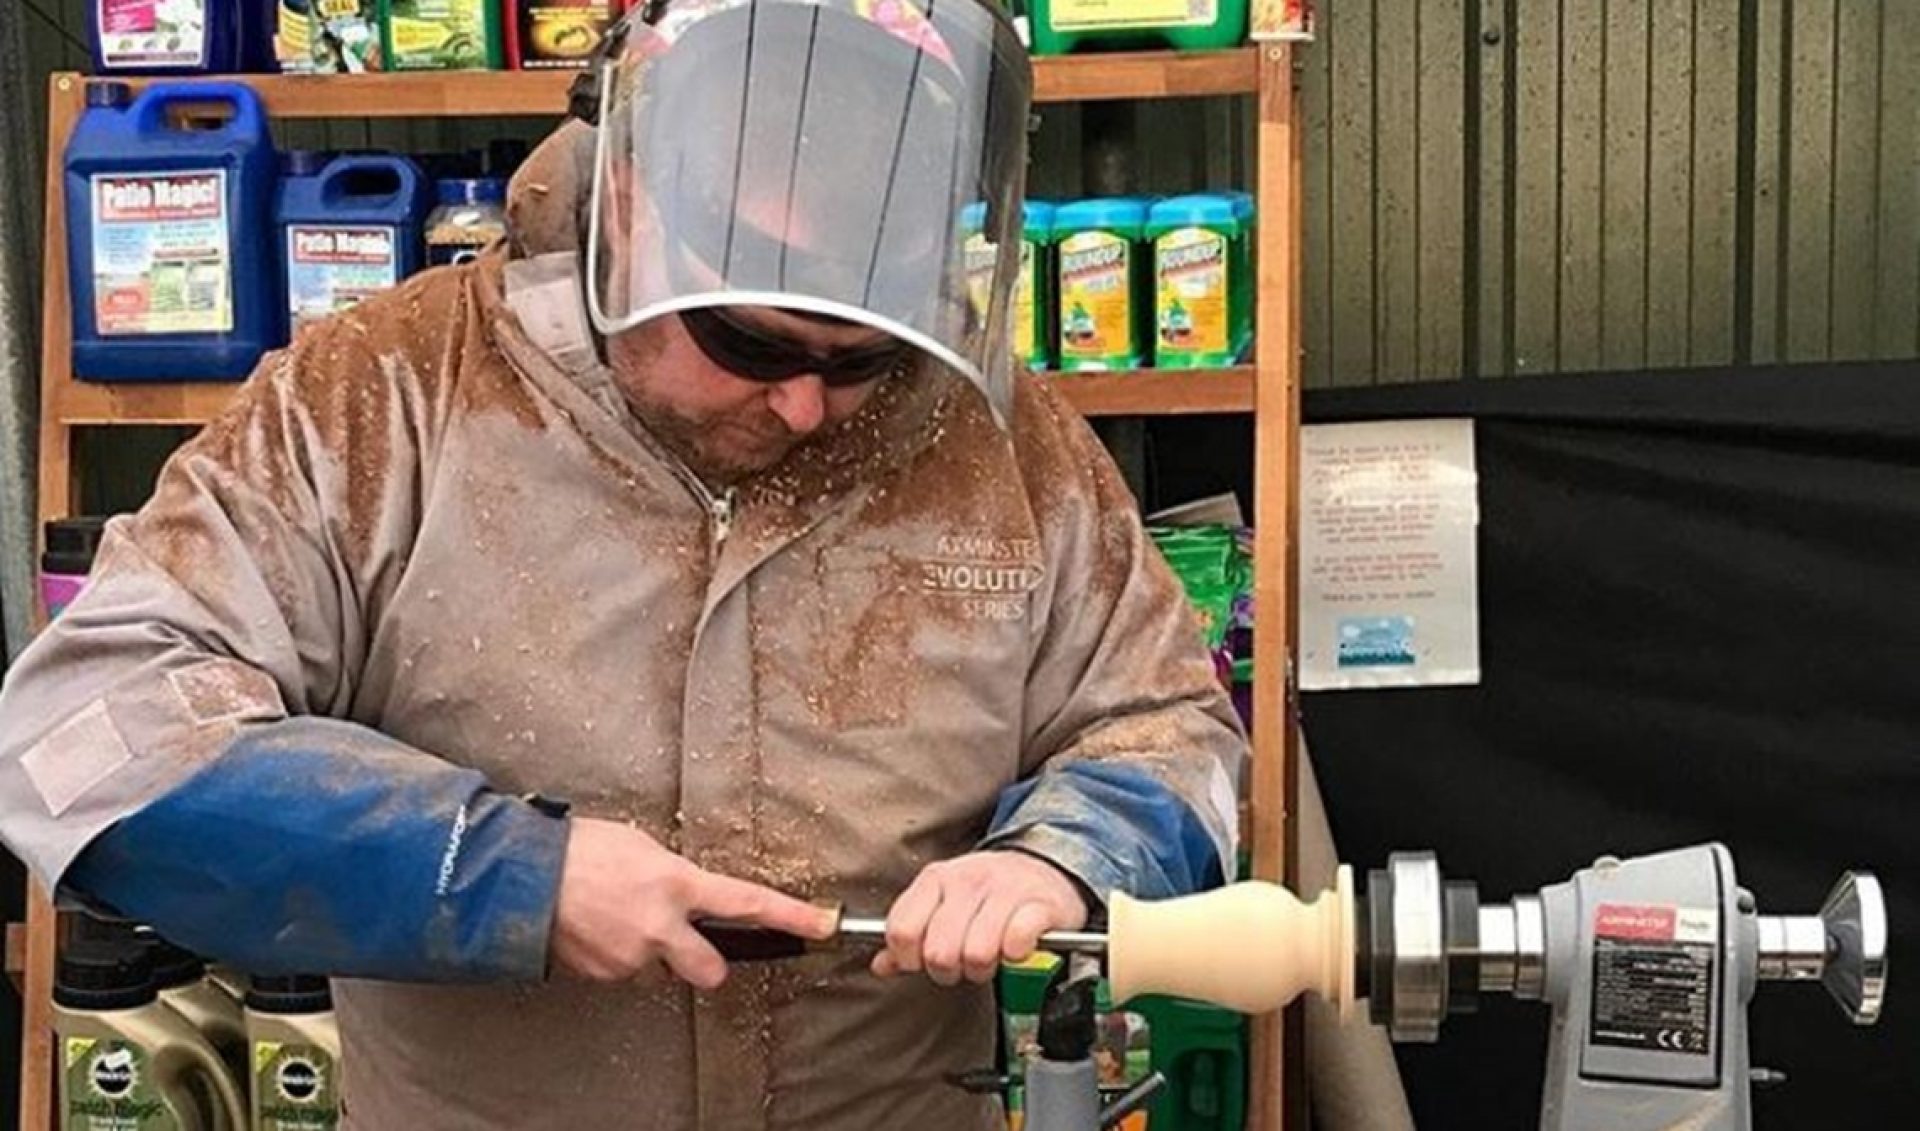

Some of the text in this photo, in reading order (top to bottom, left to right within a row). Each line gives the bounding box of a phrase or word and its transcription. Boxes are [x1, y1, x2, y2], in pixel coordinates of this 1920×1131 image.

[103, 181, 152, 212] Patio
[296, 231, 333, 254] Patio
[961, 600, 1024, 619] SERIES
